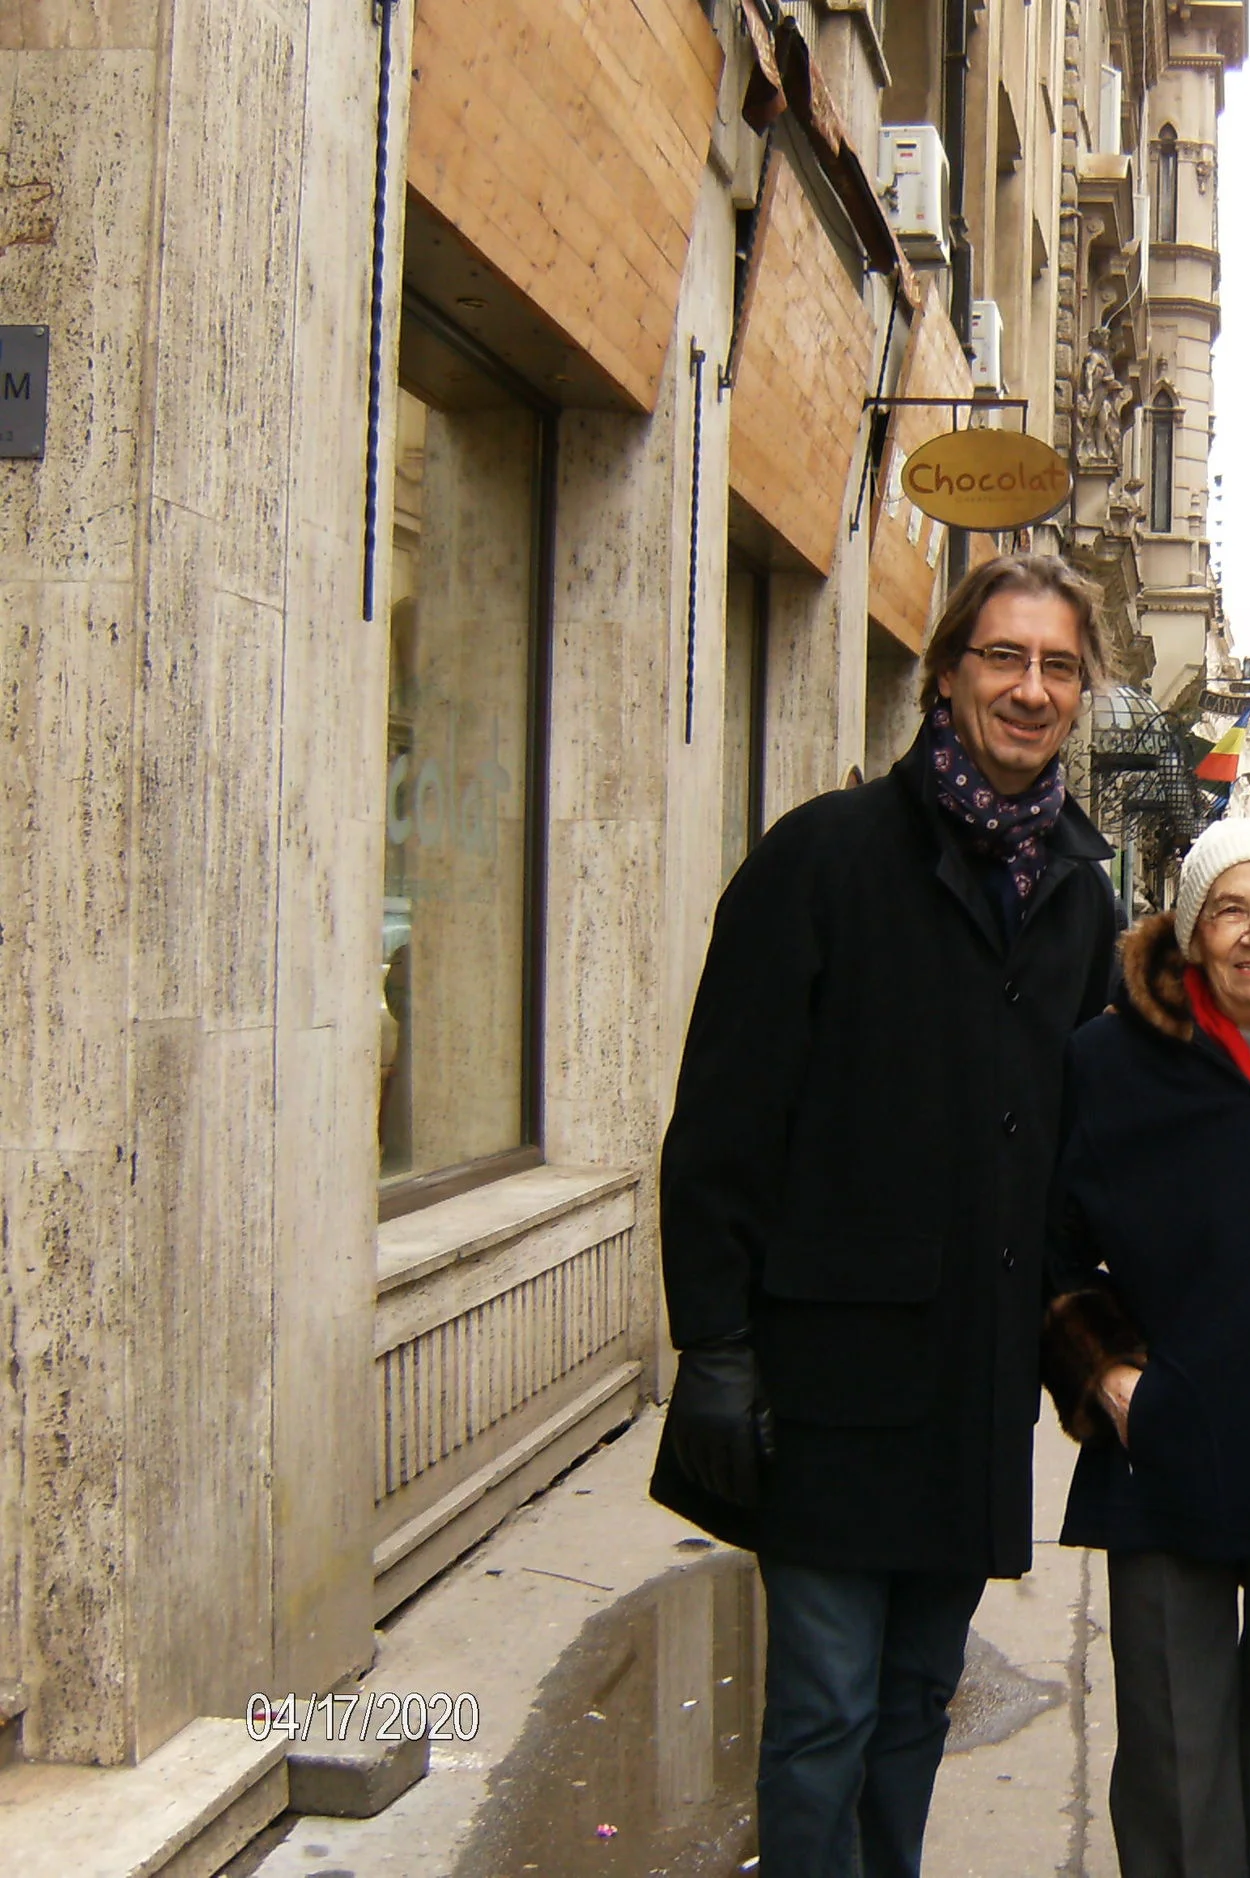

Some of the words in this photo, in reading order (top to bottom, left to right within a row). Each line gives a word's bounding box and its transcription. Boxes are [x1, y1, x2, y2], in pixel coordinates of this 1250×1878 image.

[4, 371, 31, 400] M
[908, 461, 1065, 495] Chocolat
[386, 711, 512, 866] colat
